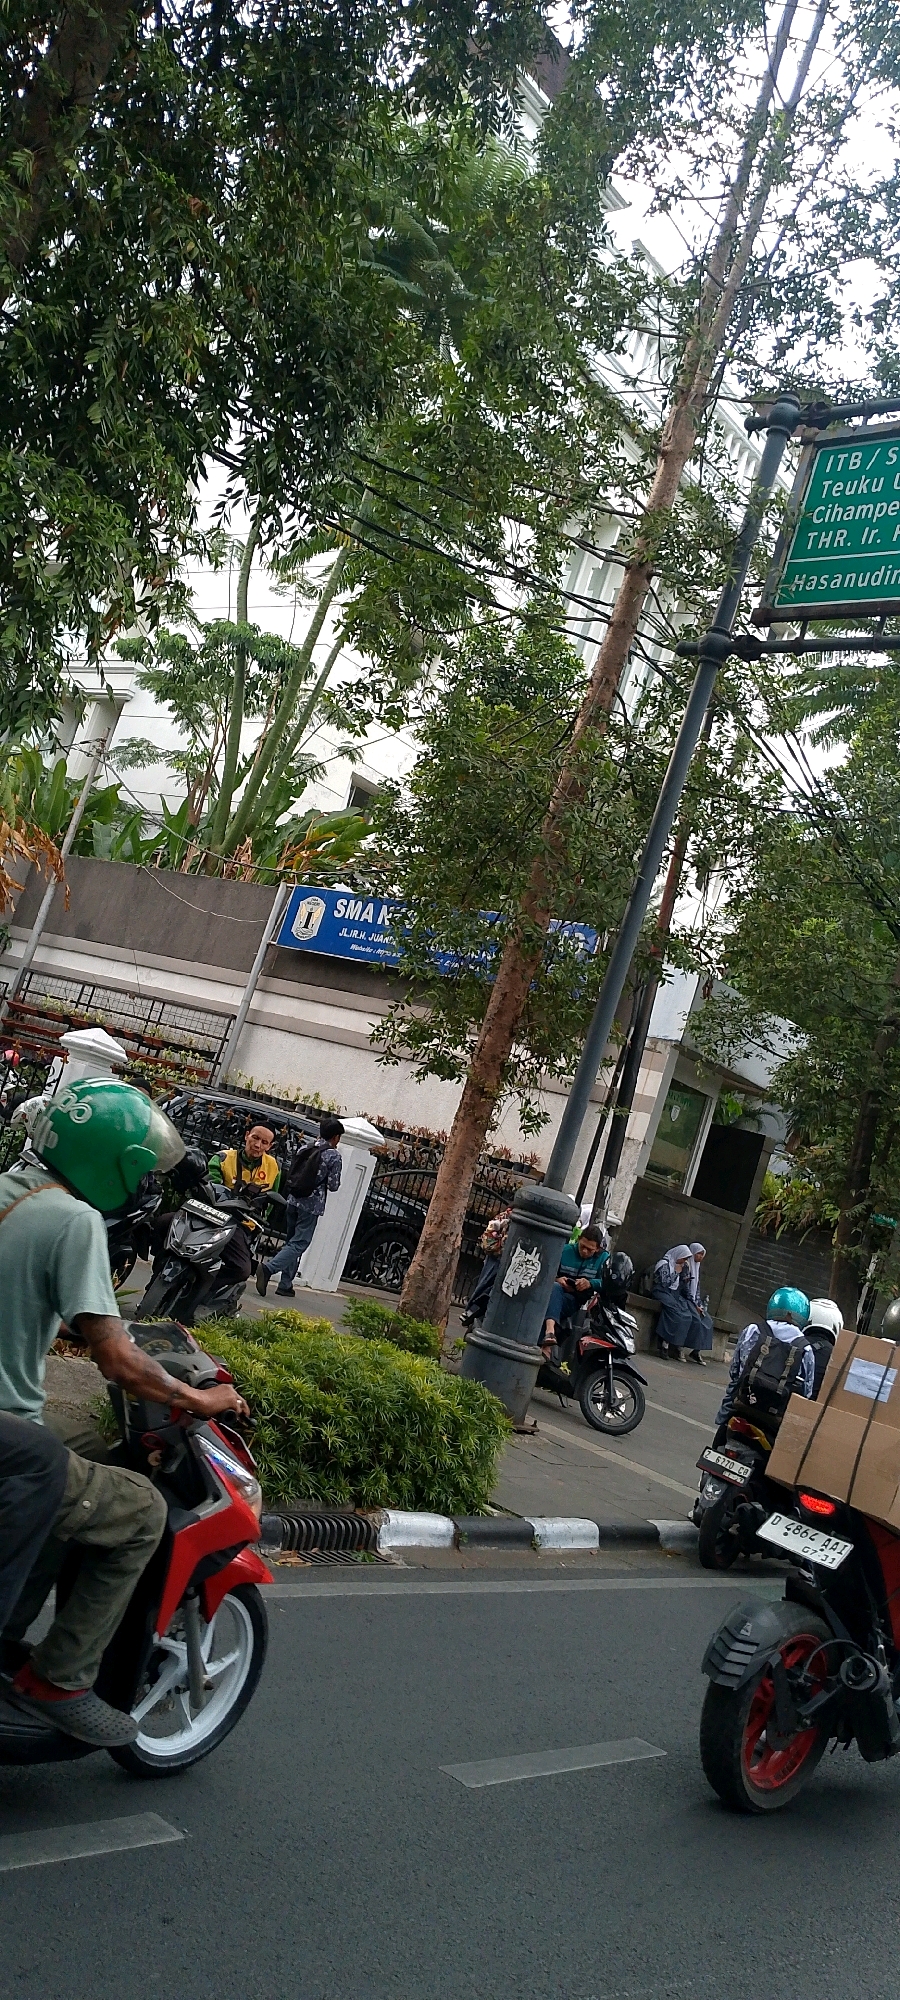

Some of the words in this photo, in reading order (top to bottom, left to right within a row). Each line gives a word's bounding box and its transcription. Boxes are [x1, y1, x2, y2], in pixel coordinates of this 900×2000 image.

[825, 450, 863, 473] ITB
[865, 447, 881, 471] /
[822, 474, 885, 499] Teuku
[812, 500, 900, 524] Cihampe
[806, 528, 852, 550] THR.
[860, 526, 881, 545] Ir.
[333, 898, 374, 923] SMA
[704, 1450, 712, 1459] Z
[770, 1515, 783, 1526] D
[784, 1522, 819, 1542] 4864
[820, 1537, 849, 1556] AAI
